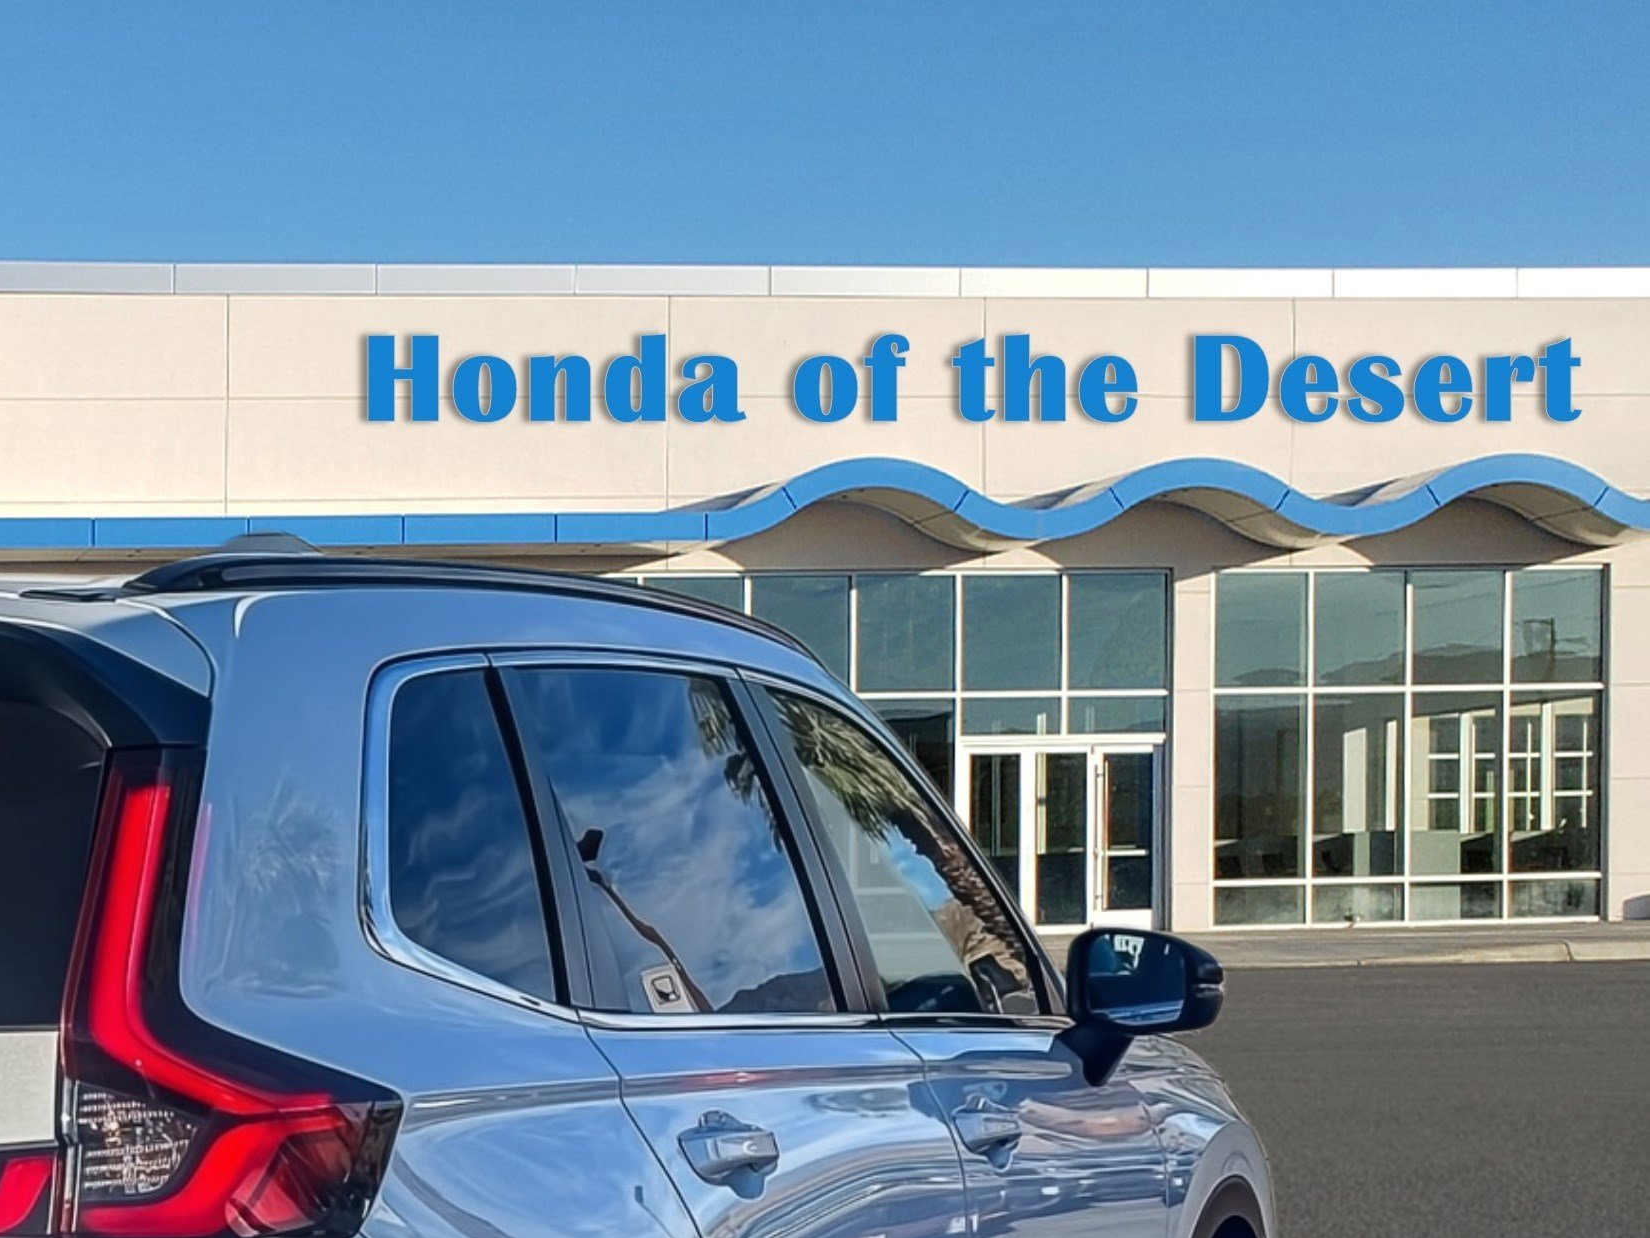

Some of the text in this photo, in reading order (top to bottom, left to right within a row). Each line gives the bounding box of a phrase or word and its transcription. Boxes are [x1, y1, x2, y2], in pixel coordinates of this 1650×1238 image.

[366, 332, 1583, 424] Honda of the Desert
